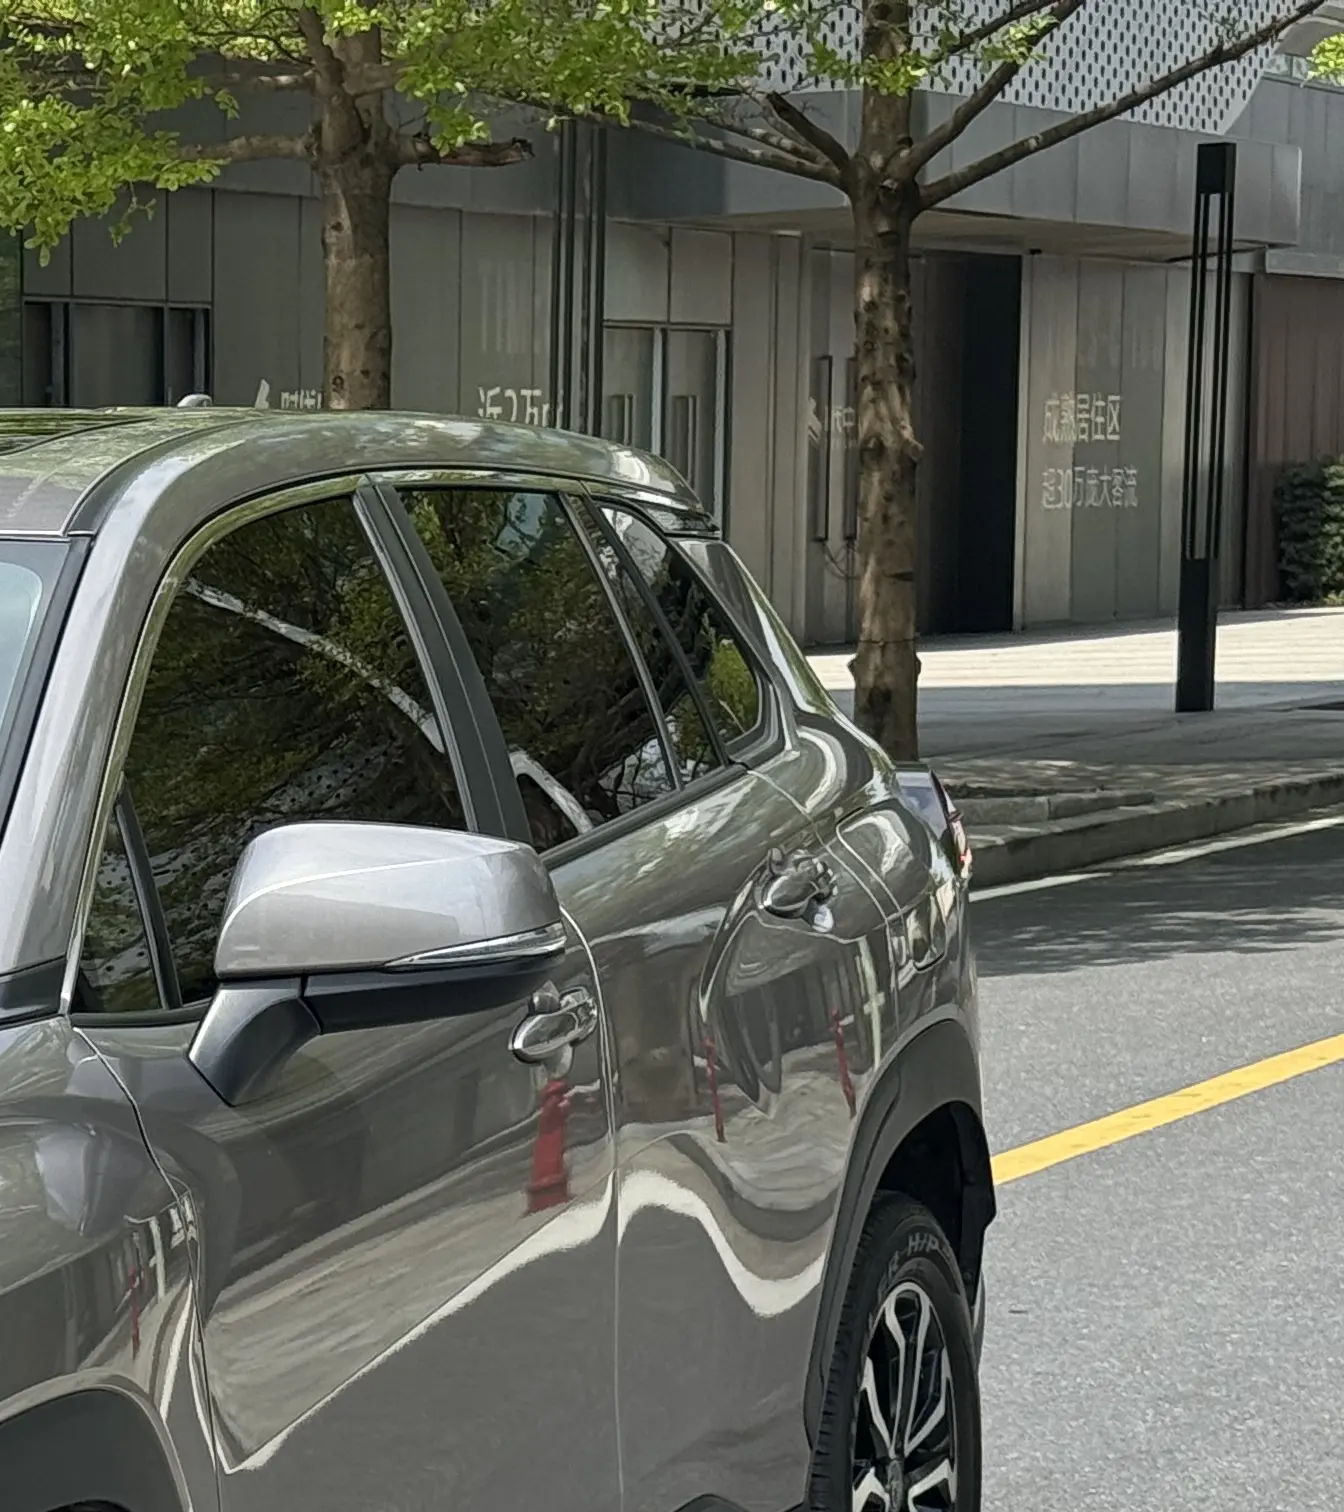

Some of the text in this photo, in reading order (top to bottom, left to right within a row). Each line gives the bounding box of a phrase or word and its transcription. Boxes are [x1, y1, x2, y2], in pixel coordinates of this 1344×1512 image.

[1043, 392, 1121, 443] 成熟居住区
